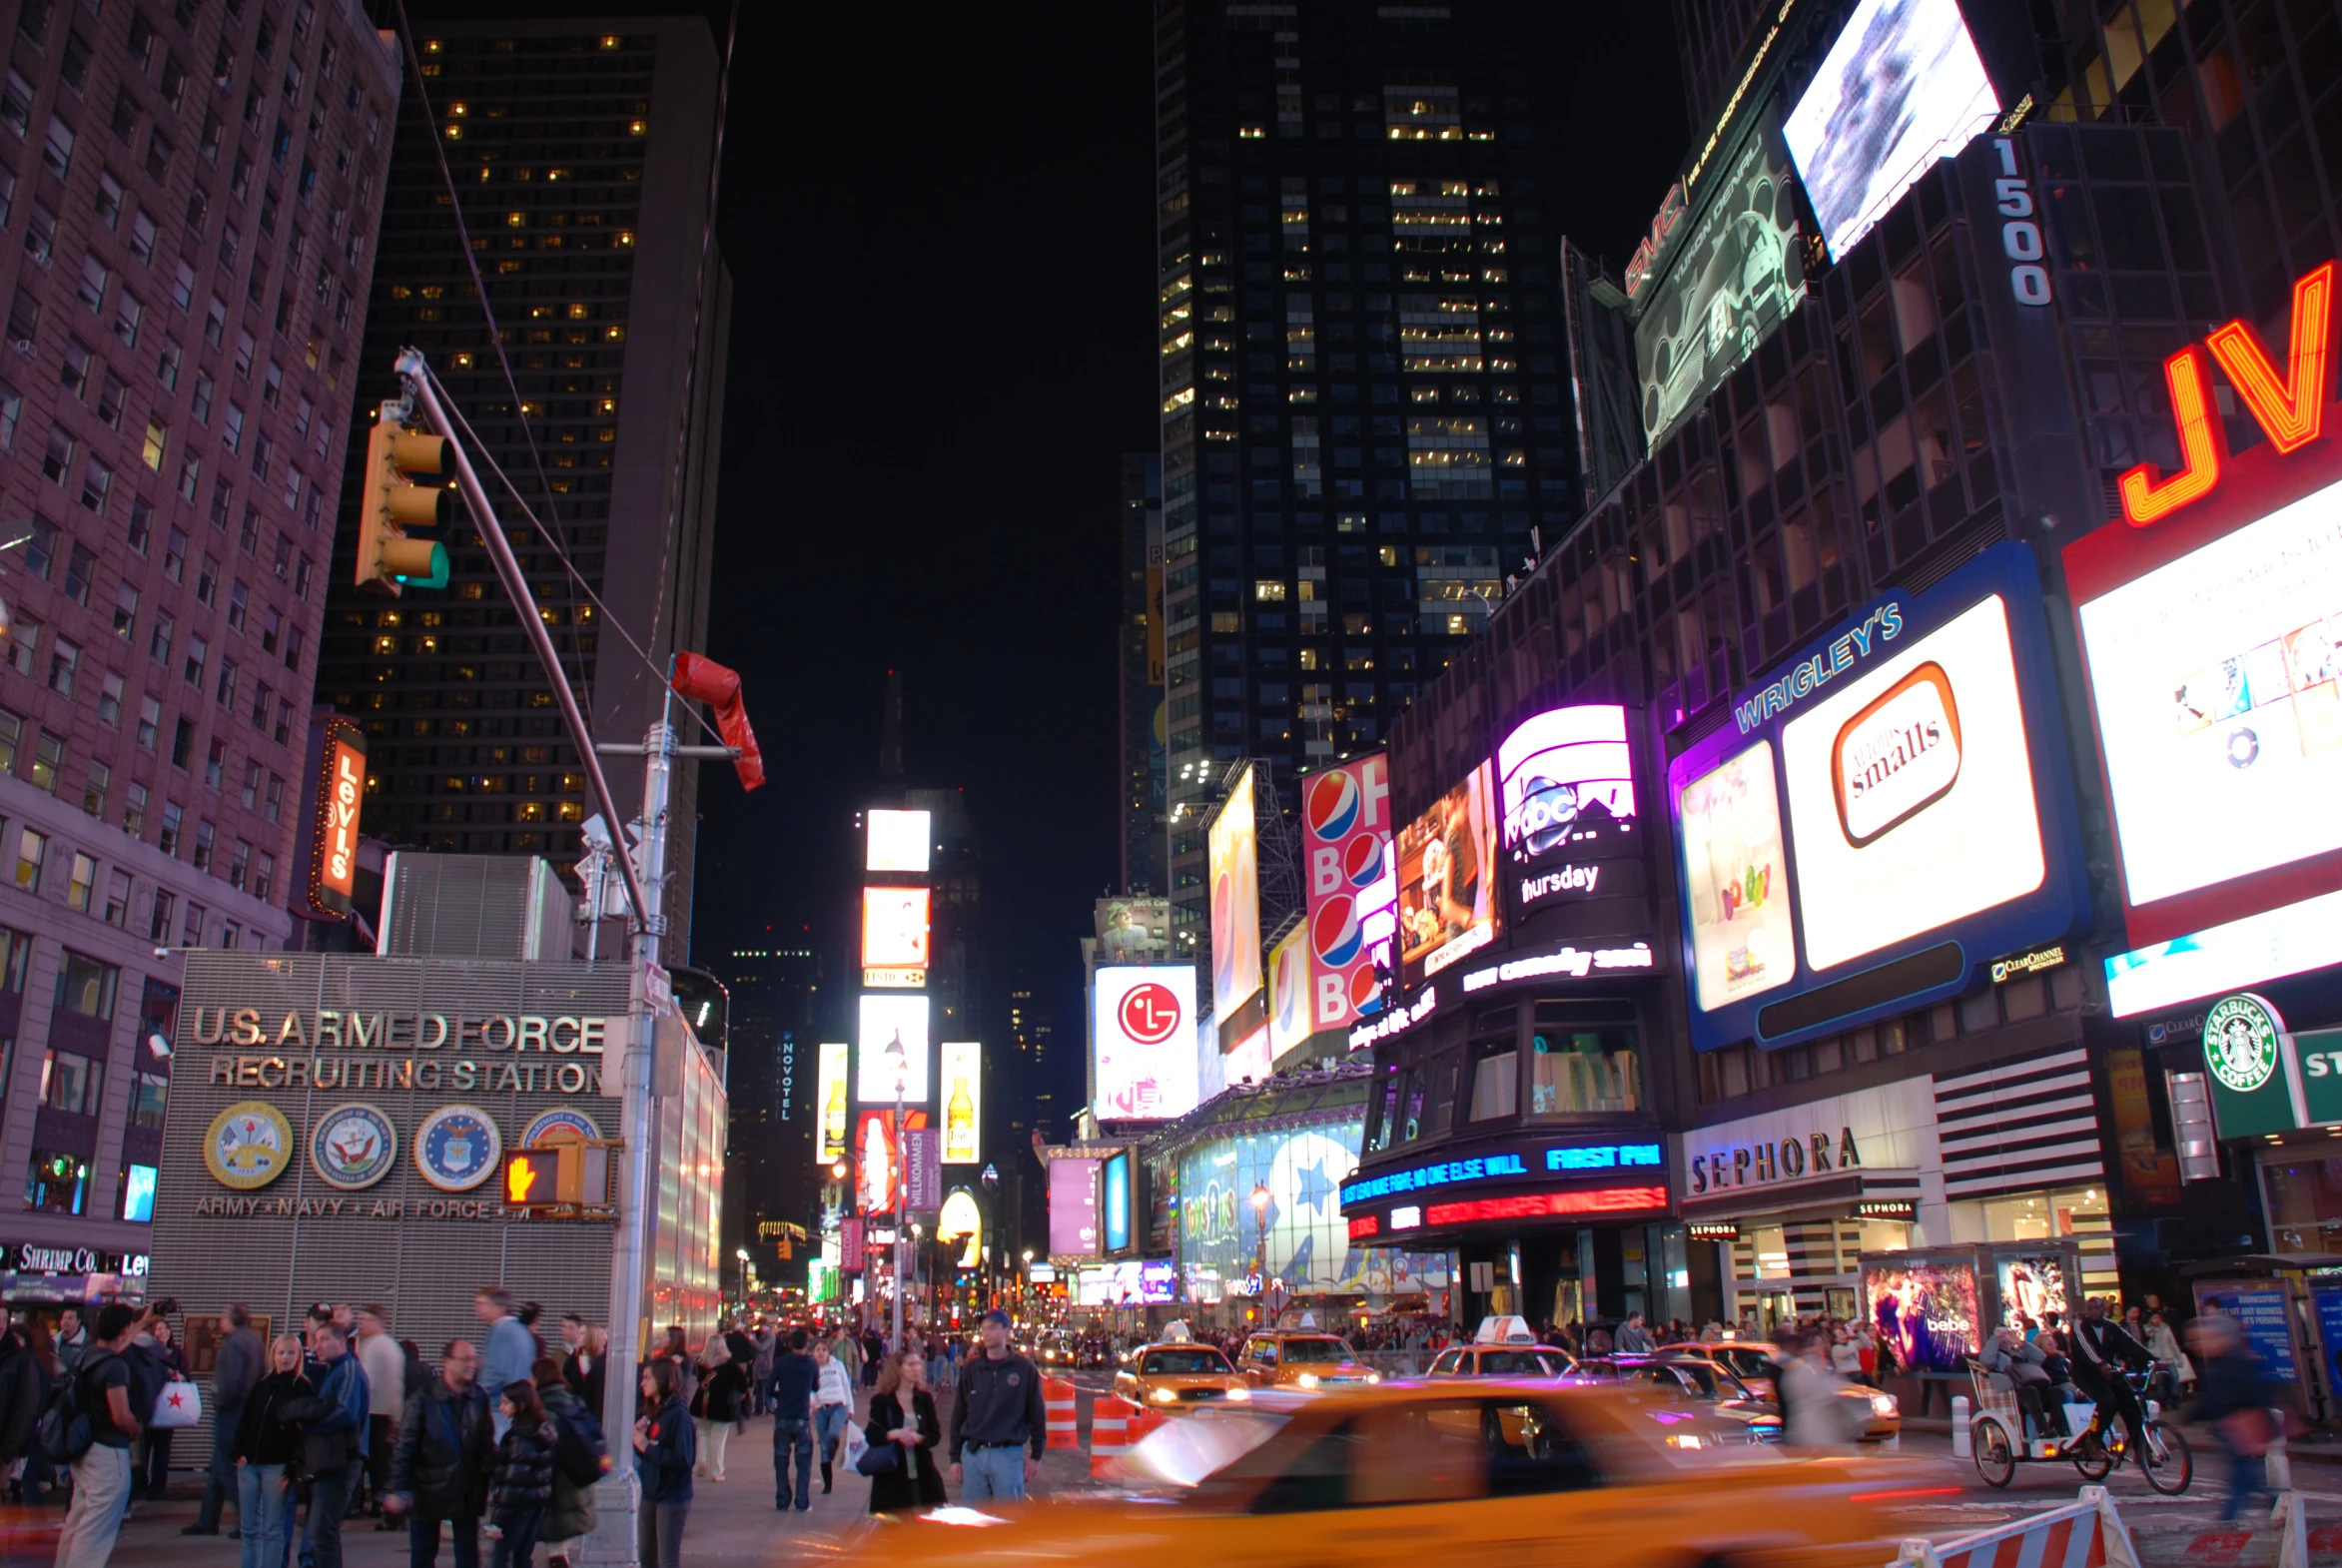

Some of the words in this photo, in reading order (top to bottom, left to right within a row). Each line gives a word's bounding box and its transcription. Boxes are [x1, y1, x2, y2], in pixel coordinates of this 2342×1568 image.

[1688, 162, 1701, 187] WE
[1701, 133, 1718, 166] ARE
[1717, 26, 1779, 135] PROFESSIONAL
[1674, 222, 1712, 284] YUKON
[1713, 133, 1762, 222] DENALI
[1993, 139, 2051, 306] 1500
[1626, 184, 1682, 297] GMC
[1735, 603, 1903, 734] WRIGLEY'S
[1853, 720, 1941, 799] smalls
[1520, 793, 1578, 836] abc
[194, 1007, 267, 1046] U.S.
[275, 1010, 447, 1050] ARMED
[454, 1014, 605, 1054] FORCE
[1122, 986, 1177, 1042] LG
[2207, 1000, 2271, 1046] STARBUCKS
[210, 1055, 441, 1090] RECRUITING
[451, 1061, 602, 1093] STATION
[782, 1044, 793, 1121] NOVOTEL
[2218, 1059, 2270, 1087] COFFEE
[525, 1114, 563, 1148] EPARTMENT
[912, 1133, 923, 1206] WILLKOMMEN
[1427, 1164, 1449, 1184] ONE
[1449, 1159, 1484, 1180] ELSE
[1484, 1154, 1527, 1176] WILL
[1692, 1127, 1861, 1193] SEPHORA
[195, 1198, 260, 1215] ARMY
[278, 1198, 344, 1215] NAVY
[372, 1199, 404, 1217] AIR
[416, 1201, 490, 1218] FORCE
[1690, 1225, 1737, 1234] SEPHORA
[1860, 1202, 1913, 1214] SEPHORA
[844, 1221, 853, 1266] WELCOME
[2071, 1254, 2081, 1296] Newsstand
[1928, 1318, 1969, 1331] bebe
